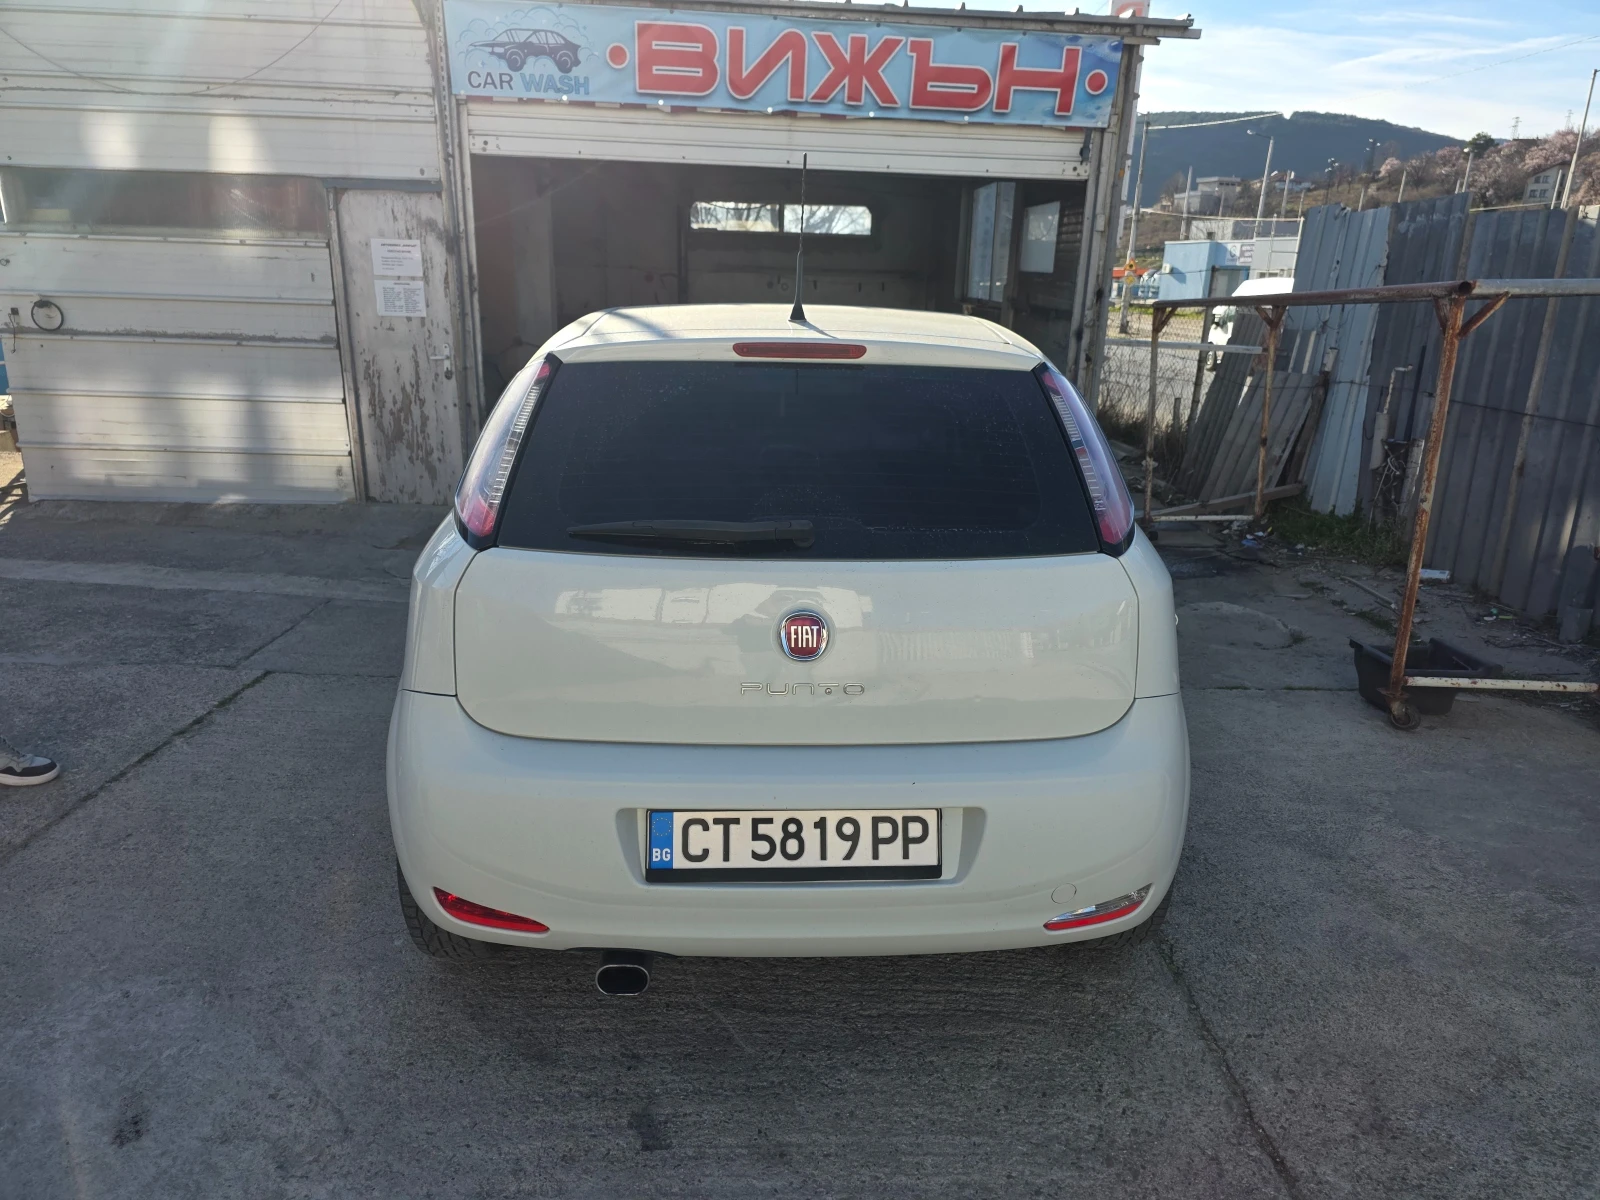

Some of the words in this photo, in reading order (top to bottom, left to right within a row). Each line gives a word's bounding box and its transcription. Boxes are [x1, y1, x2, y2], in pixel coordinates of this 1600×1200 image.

[635, 20, 1082, 116] ВИЖЪН
[467, 70, 514, 91] CAR
[520, 72, 590, 95] WASH
[790, 625, 819, 648] FIAT
[740, 682, 865, 695] PUNTO
[652, 848, 671, 862] BG
